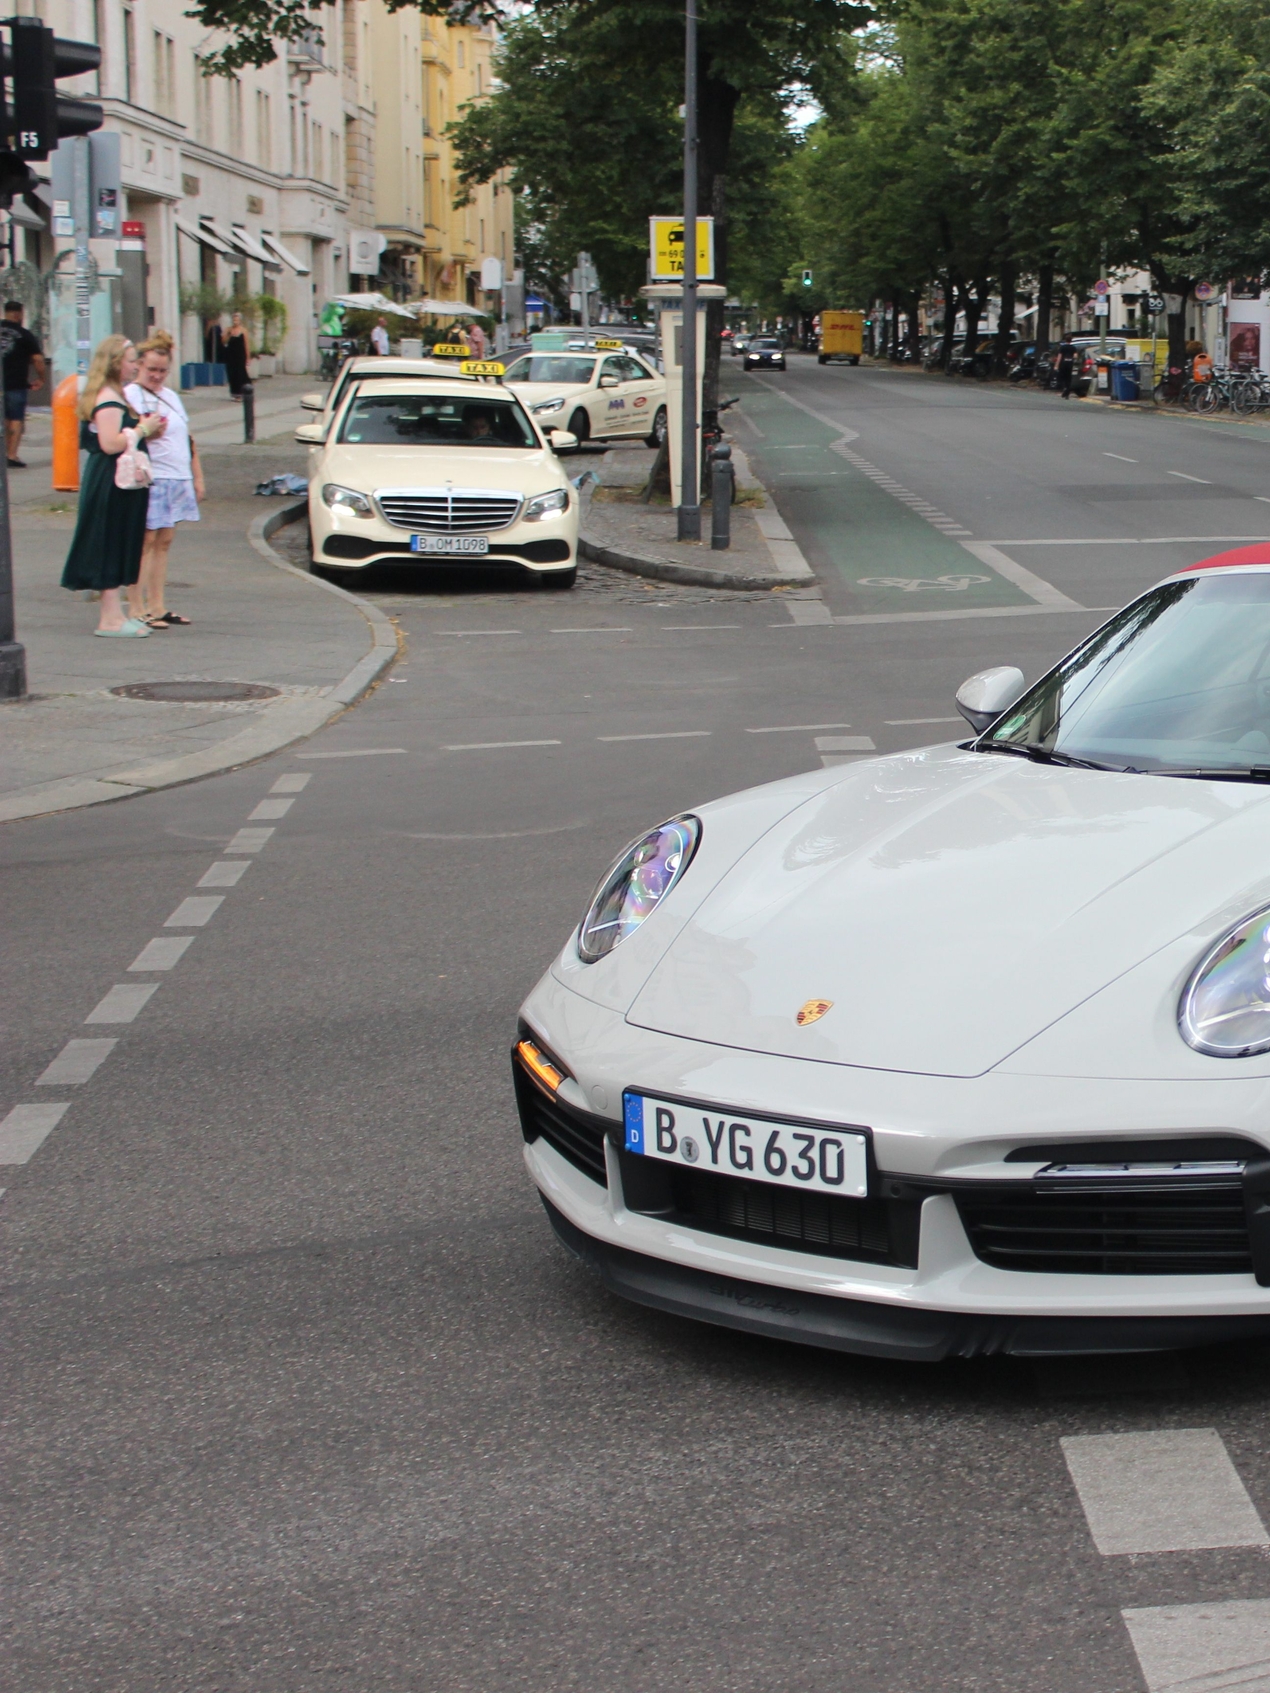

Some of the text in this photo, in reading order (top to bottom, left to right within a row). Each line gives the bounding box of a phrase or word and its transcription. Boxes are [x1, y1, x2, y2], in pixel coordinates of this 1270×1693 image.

[20, 131, 39, 148] F5
[440, 346, 465, 354] TAXI
[466, 363, 498, 373] TAXI
[420, 538, 427, 549] B
[455, 539, 486, 551] 1098
[631, 1130, 639, 1143] D
[656, 1107, 845, 1186] B YG 630
